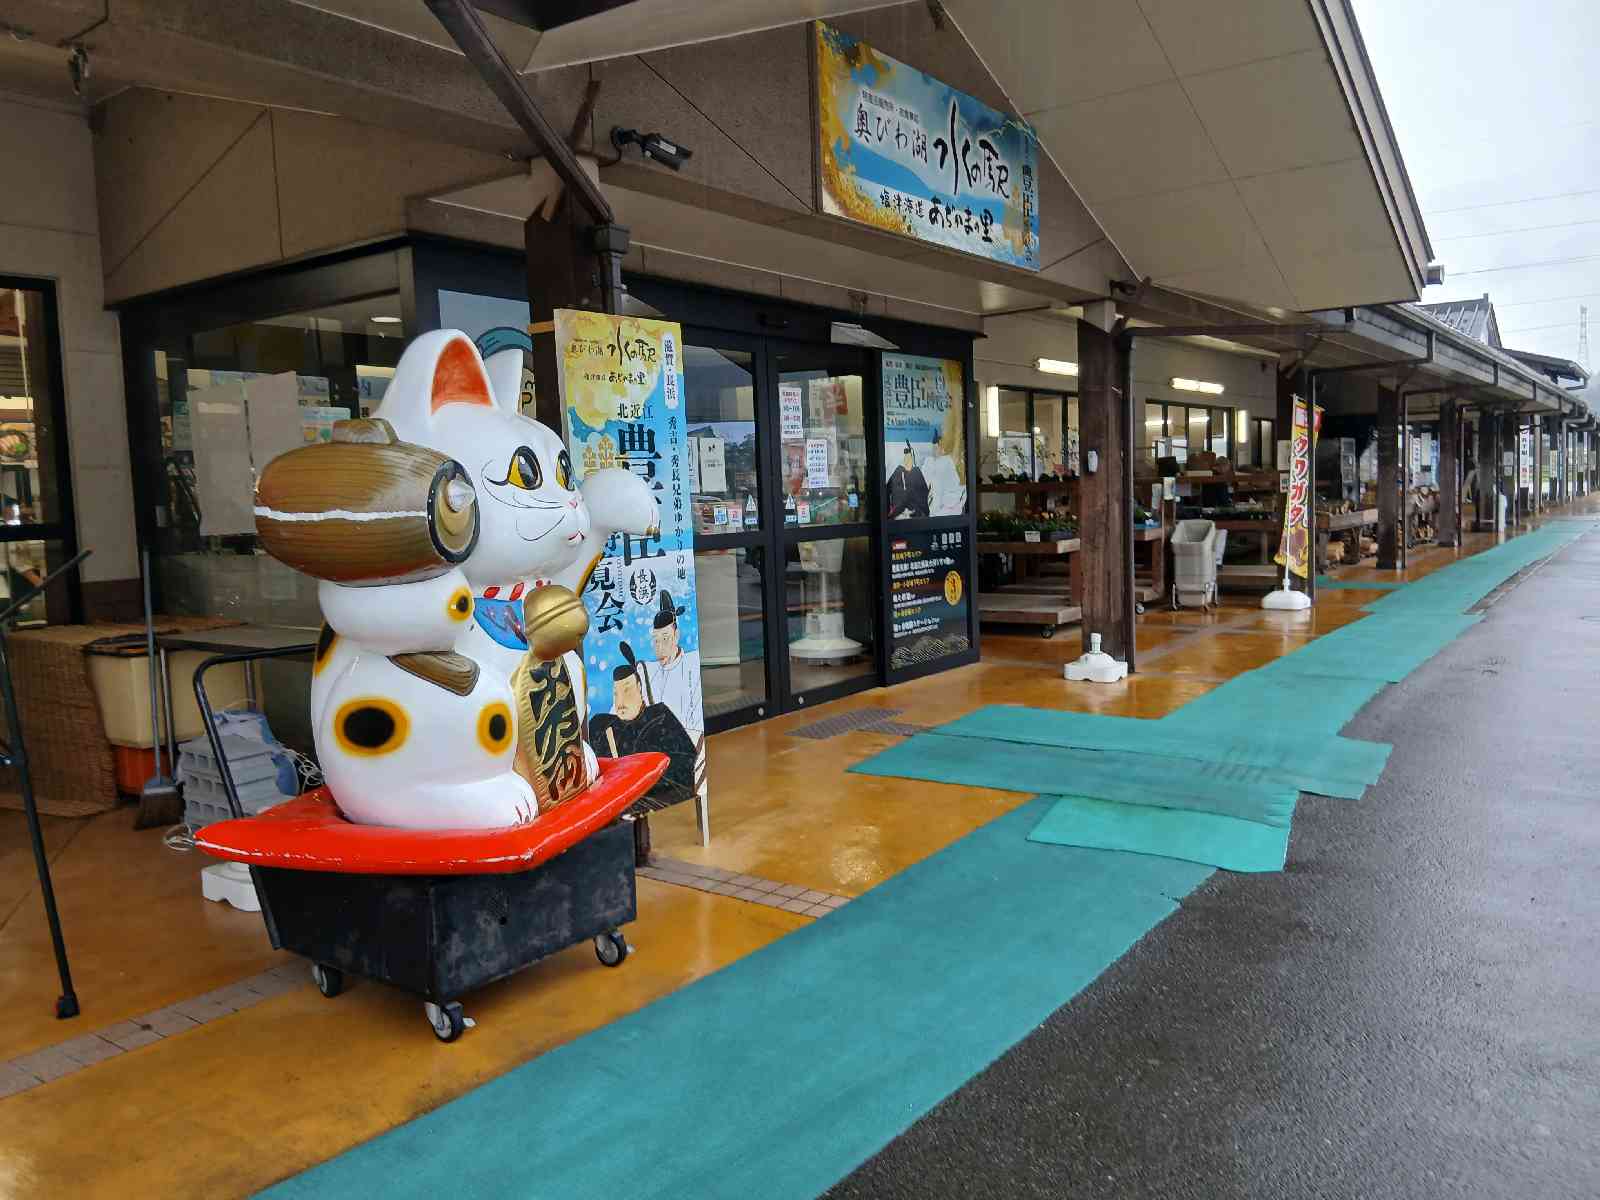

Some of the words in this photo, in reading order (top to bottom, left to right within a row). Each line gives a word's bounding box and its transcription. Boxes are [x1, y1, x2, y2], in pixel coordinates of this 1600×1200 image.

[854, 103, 928, 163] 奥びわ湖
[933, 97, 1010, 198] 水の駅
[606, 326, 657, 366] 水の駅
[617, 402, 654, 420] 北近江
[668, 416, 687, 580] 秀吉・秀長兄弟ゆかりの地
